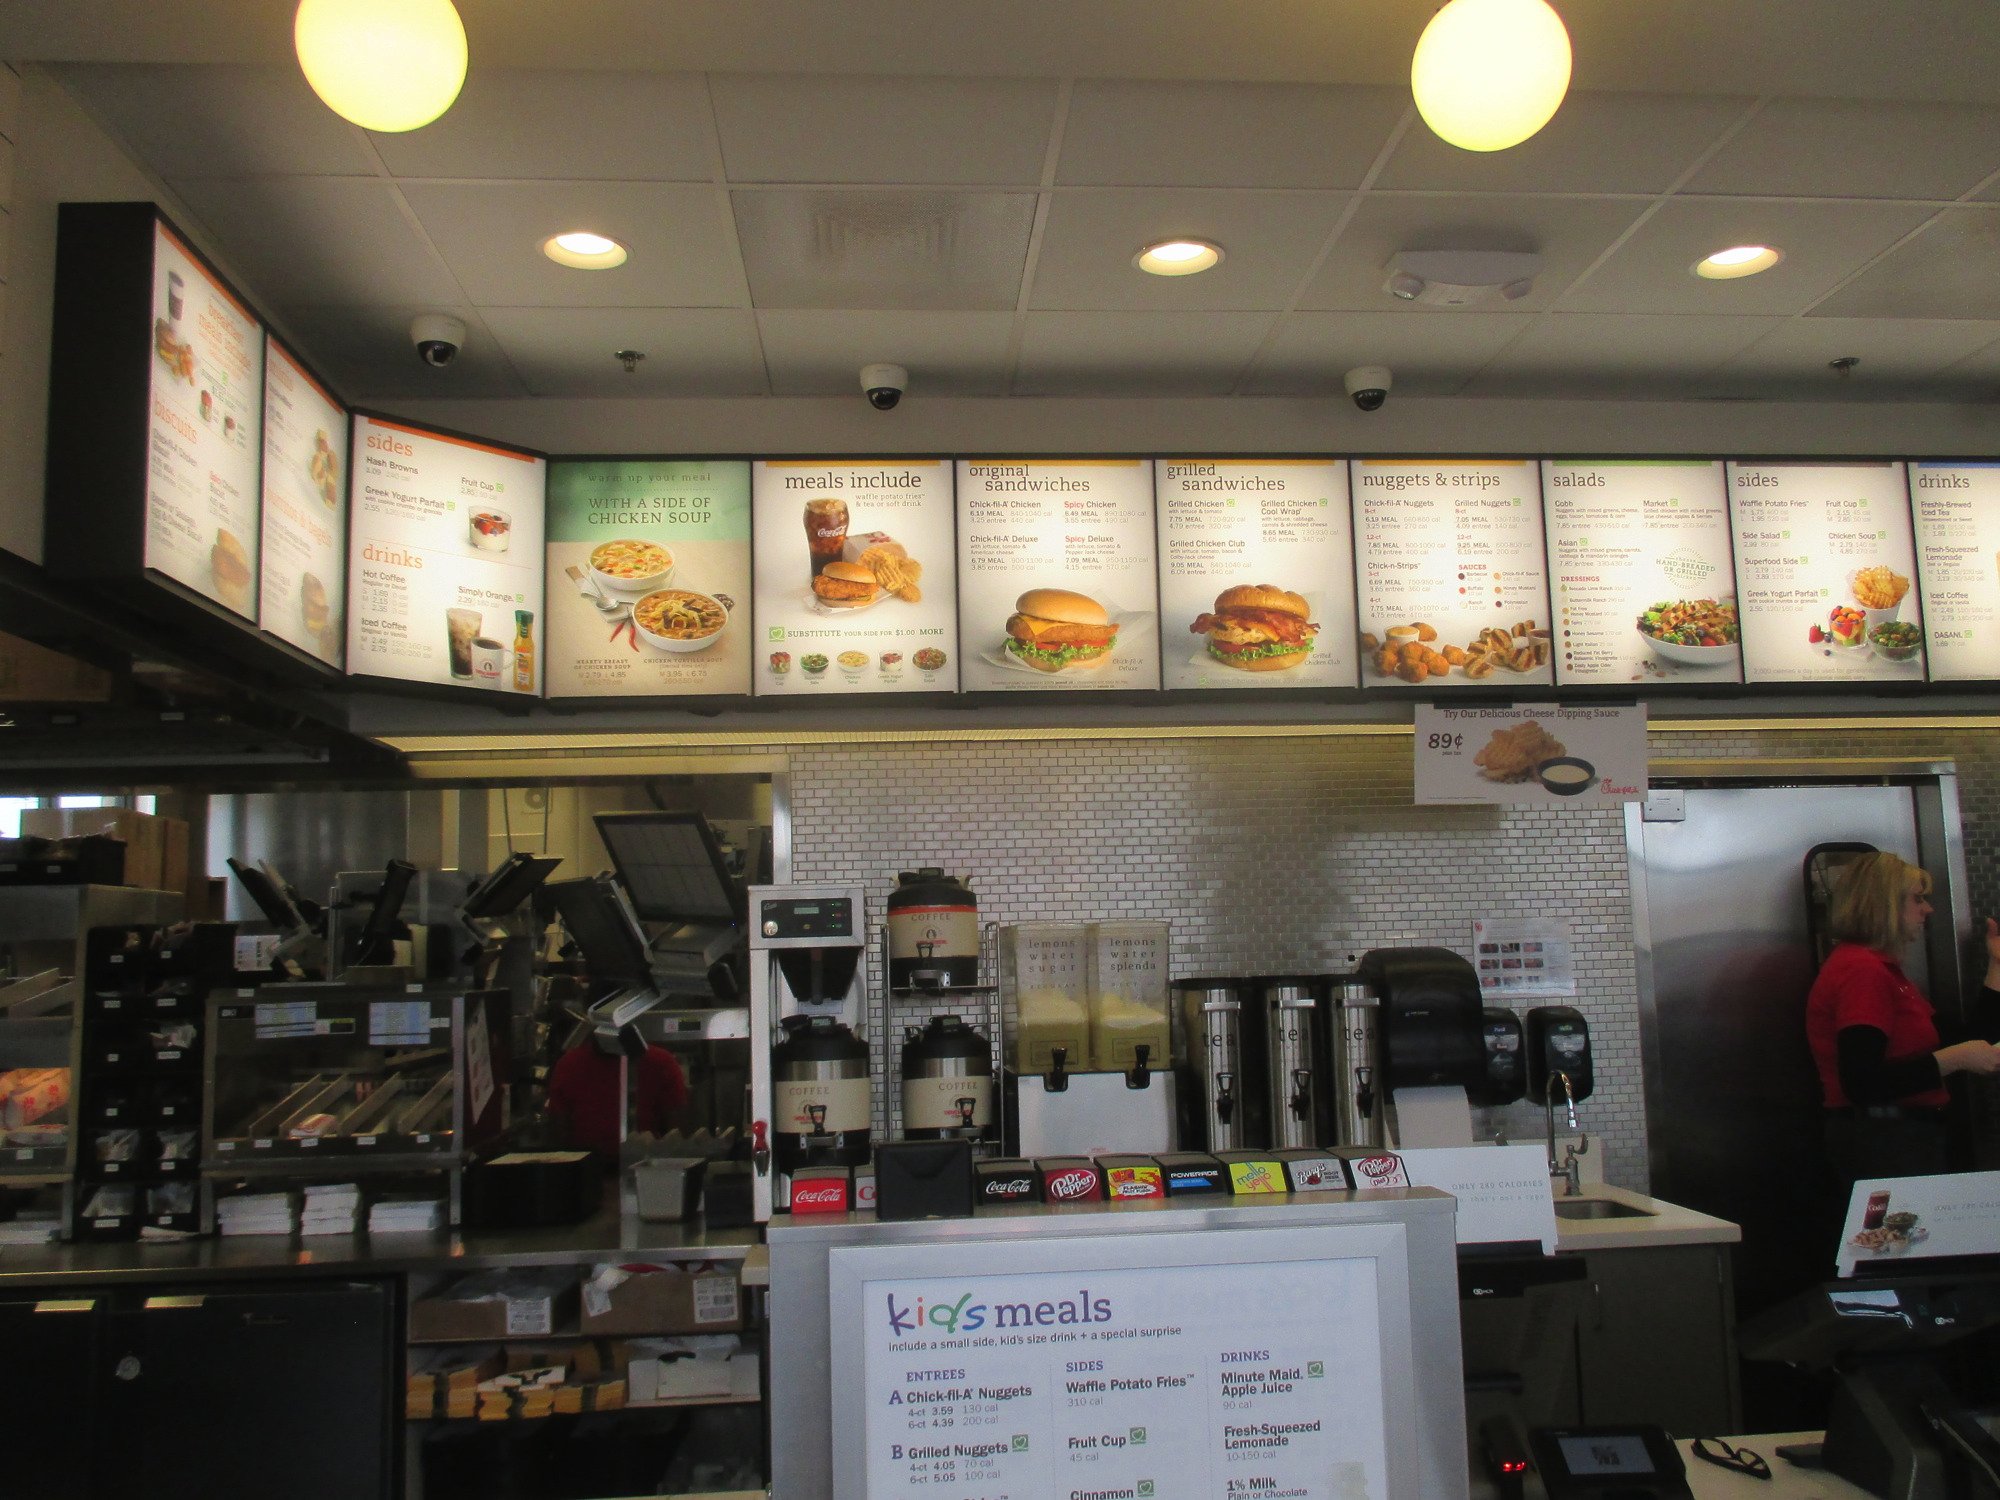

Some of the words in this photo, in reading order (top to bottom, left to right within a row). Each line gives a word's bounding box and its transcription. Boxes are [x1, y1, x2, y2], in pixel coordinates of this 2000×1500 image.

[367, 433, 414, 456] sides
[366, 456, 387, 467] Hash
[389, 461, 419, 475] Browns
[969, 464, 1029, 479] original
[1167, 463, 1216, 479] grilled
[588, 473, 622, 482] warm
[629, 474, 643, 484] up
[682, 473, 711, 482] meal
[785, 472, 844, 489] meals
[850, 471, 922, 488] include
[985, 477, 1090, 492] sandwiches
[1182, 476, 1285, 491] sandwiches
[1363, 474, 1430, 490] nuggets
[1435, 472, 1448, 487] &
[1452, 472, 1500, 490] strips
[1553, 473, 1606, 487] salads
[1737, 473, 1779, 488] sides
[1918, 474, 1970, 489] drinks
[589, 498, 631, 509] WITH
[637, 498, 647, 509] A
[653, 497, 686, 508] SIDE
[692, 497, 711, 507] OF
[1064, 501, 1085, 509] Spicy
[1168, 500, 1193, 508] Grilled
[1195, 500, 1225, 508] Chicken
[1455, 499, 1478, 507] Grilled
[1480, 499, 1511, 508] Nuggets
[1843, 500, 1857, 508] Cup
[1921, 501, 1972, 509] Freshly-Brewed
[588, 512, 662, 525] CHICKEN
[668, 512, 711, 524] SOUP
[1065, 535, 1085, 544] Spicy
[1087, 535, 1114, 543] Deluxe
[1858, 532, 1877, 540] Soup
[1170, 540, 1194, 548] Grilled
[1196, 540, 1226, 548] Chicken
[1925, 546, 1979, 554] Fresh-Squeezed
[363, 543, 423, 569] drinks
[1744, 558, 1782, 566] Superfood
[363, 570, 377, 578] Hot
[380, 572, 406, 583] Coffee
[1769, 590, 1794, 598] Yogurt
[361, 618, 379, 627] Iced
[381, 620, 407, 631] Coffee
[788, 630, 841, 638] SUBSTITUTE
[1444, 709, 1458, 719] Try
[1461, 709, 1477, 718] Our
[1480, 709, 1520, 718] Delicious
[1523, 709, 1555, 718] Cheese
[1557, 709, 1592, 720] Dipping
[1594, 709, 1620, 718] Sauce
[1428, 733, 1464, 750] 89¢
[911, 913, 951, 922] COFFEE
[1028, 939, 1075, 949] lemons
[1110, 938, 1156, 947] lemons
[1029, 952, 1076, 960] water
[1110, 950, 1156, 958] water
[1028, 964, 1076, 974] sugar
[1110, 962, 1156, 973] splenda
[1203, 1032, 1234, 1047] tea
[1279, 1027, 1309, 1042] tea
[1344, 1027, 1375, 1041] tea
[789, 1086, 830, 1095] COFFEE
[938, 1081, 978, 1091] COFFEE
[1066, 1173, 1080, 1183] Dr
[1171, 1170, 1218, 1178] POWERADE
[1237, 1167, 1266, 1185] mello
[986, 1180, 1031, 1194] Coca-Cola
[1056, 1175, 1093, 1198] Pepper
[1246, 1173, 1272, 1190] yello
[796, 1189, 843, 1203] Coca-Cola
[887, 1292, 987, 1337] kids
[995, 1289, 1113, 1328] meals
[888, 1341, 927, 1351] include
[930, 1342, 937, 1350] a
[940, 1339, 970, 1348] small
[972, 1337, 998, 1348] side,
[1000, 1335, 1024, 1346] kid's
[1026, 1335, 1047, 1344] size
[1050, 1331, 1077, 1342] drink
[1080, 1331, 1088, 1340] +
[1090, 1332, 1098, 1341] a
[1100, 1328, 1138, 1341] special
[1140, 1325, 1182, 1339] surprise
[1221, 1350, 1271, 1363] DRINKS
[1066, 1361, 1104, 1373] SIDES
[906, 1369, 966, 1382] ENTREES
[1221, 1370, 1266, 1385] Minute
[1066, 1379, 1107, 1394] Waffle
[1110, 1377, 1153, 1391] Potato
[1221, 1384, 1258, 1398] Apple
[1260, 1381, 1293, 1394] Juice
[888, 1390, 903, 1405] A
[978, 1385, 1033, 1401] Nuggets
[908, 1408, 926, 1418] 4-ct
[932, 1406, 954, 1416] 3.59
[963, 1405, 981, 1415] 130
[984, 1404, 999, 1413] cal
[1224, 1420, 1322, 1439] Fresh-Squeezed
[1068, 1436, 1098, 1449] Fruit
[1101, 1435, 1127, 1448] Cup
[1224, 1435, 1290, 1450] Lemonade
[891, 1444, 904, 1460] B
[908, 1445, 951, 1459] Grilled
[954, 1442, 1009, 1458] Nuggets
[1226, 1478, 1246, 1492] 1%
[1249, 1477, 1277, 1490] Milk
[1070, 1488, 1134, 1500] Cinnamon
[1227, 1490, 1250, 1500] Plain
[1252, 1491, 1262, 1499] or
[1264, 1487, 1308, 1499] Chocolate
